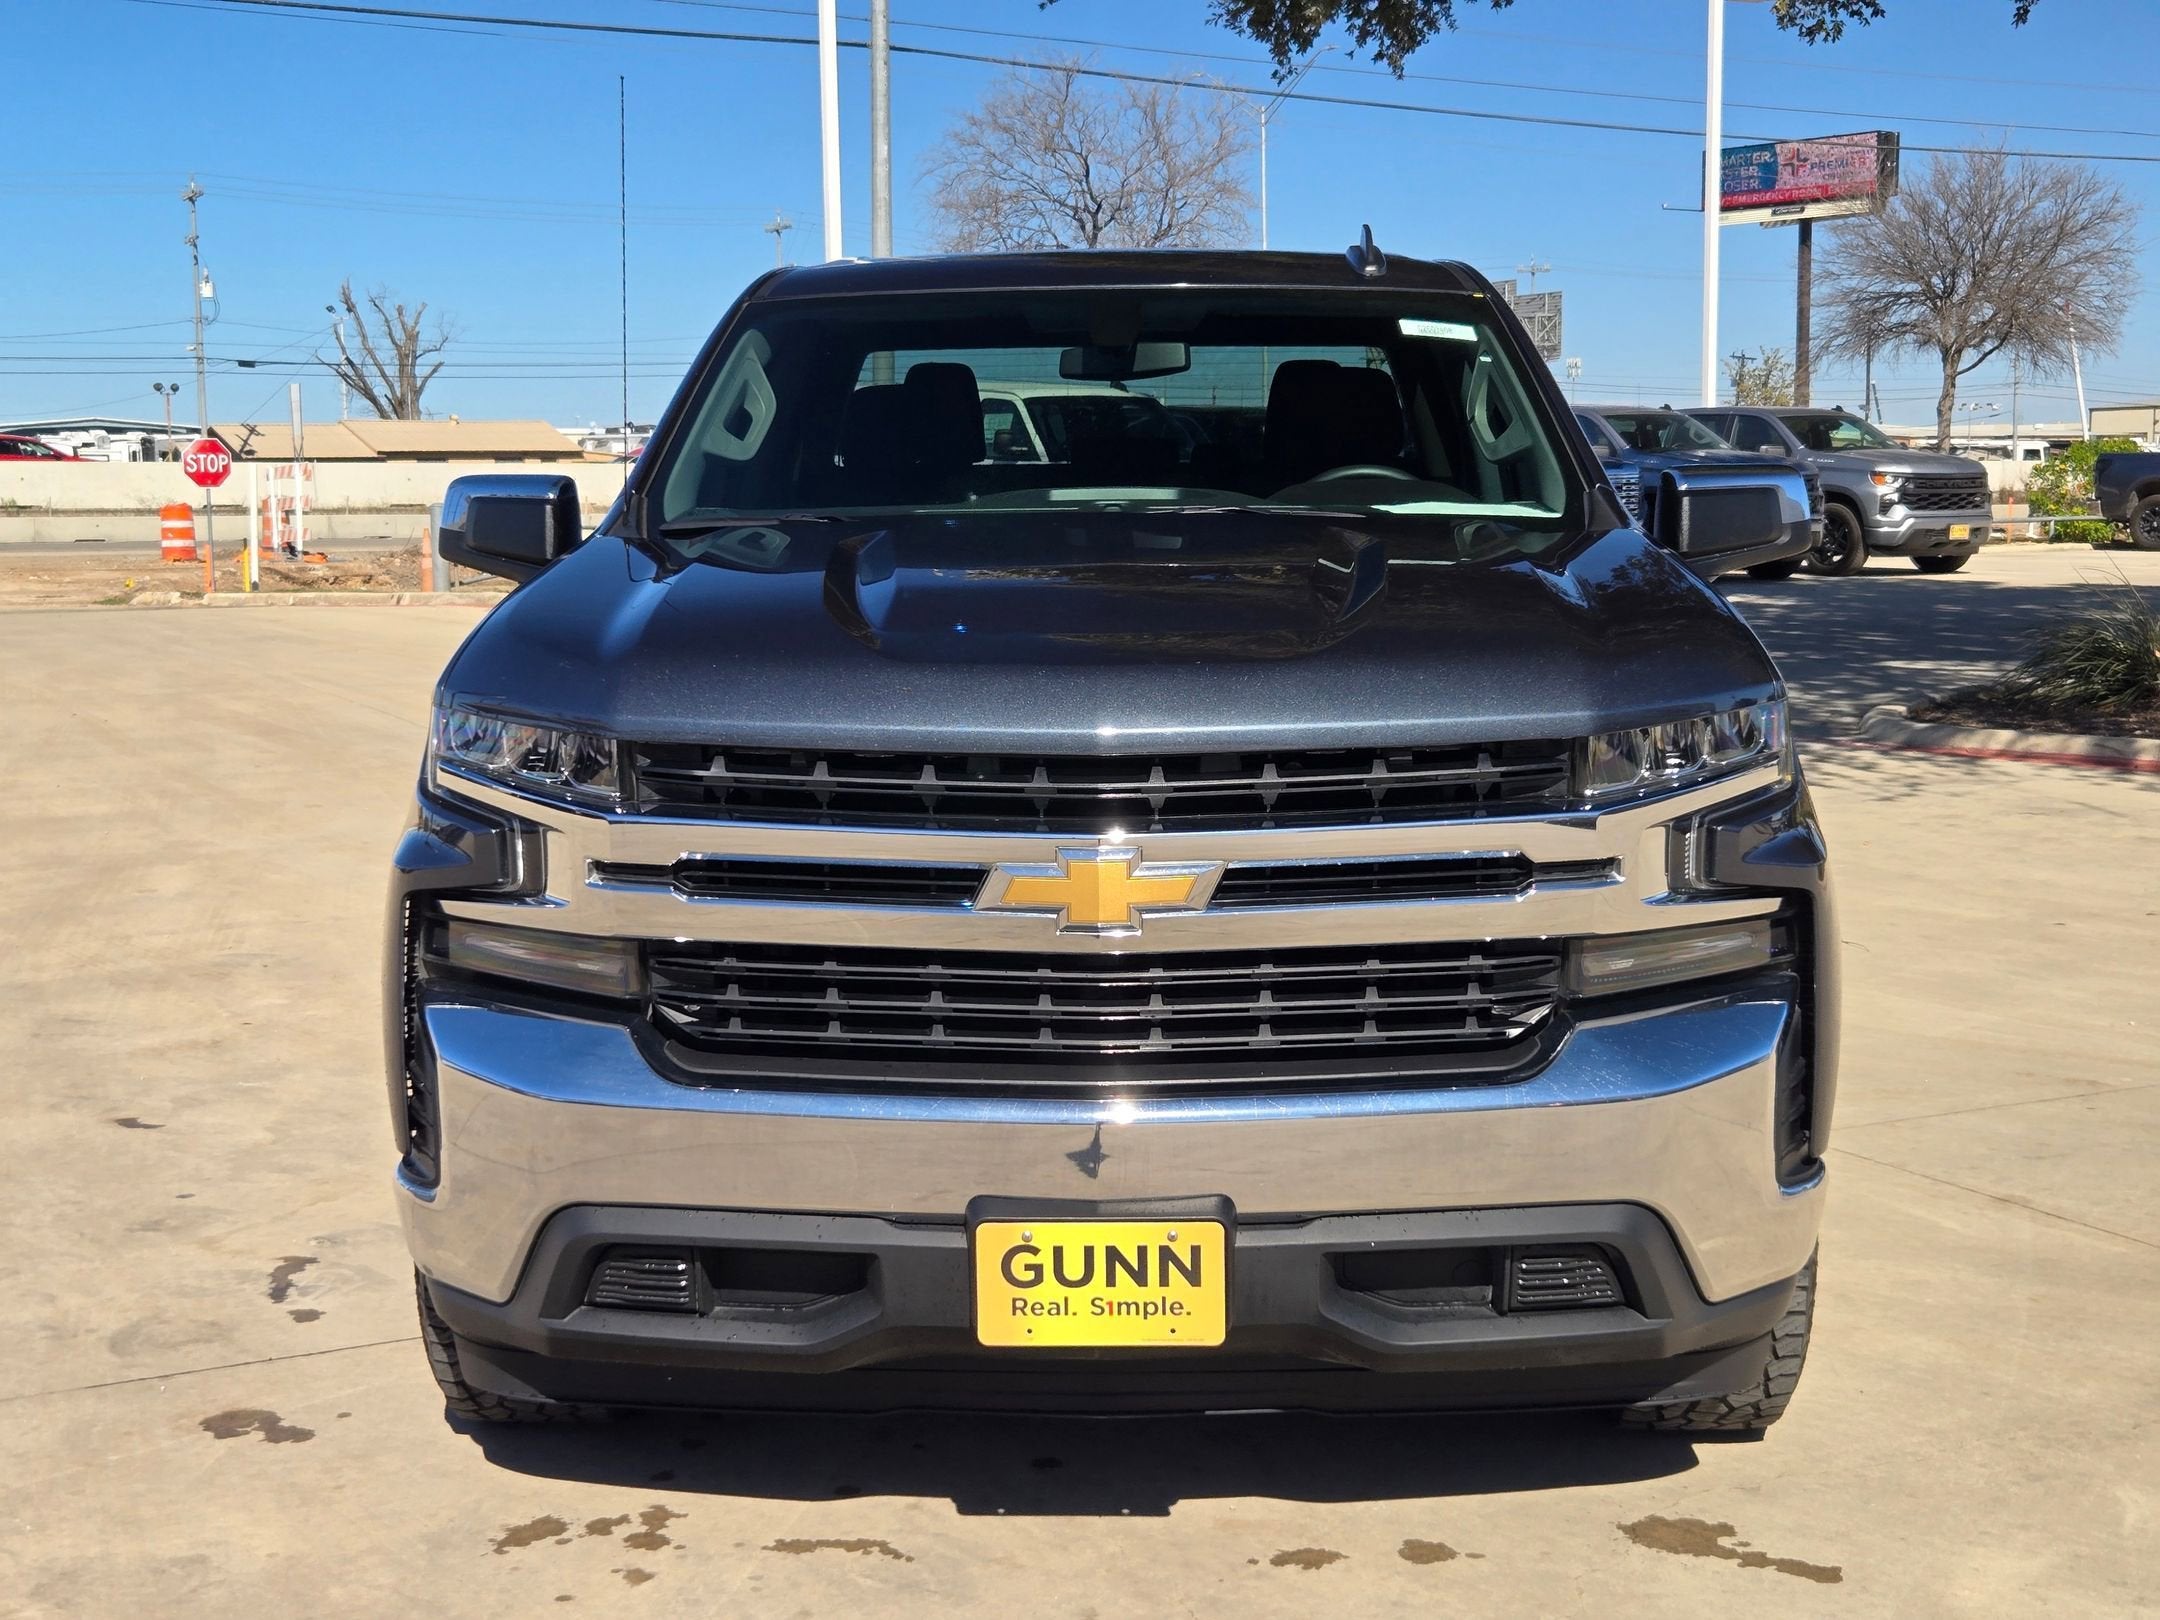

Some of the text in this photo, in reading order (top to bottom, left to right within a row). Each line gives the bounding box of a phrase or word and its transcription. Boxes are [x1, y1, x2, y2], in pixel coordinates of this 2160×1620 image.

[186, 453, 229, 473] STOP
[1000, 1243, 1202, 1289] GUNN
[1011, 1296, 1078, 1317] Real.
